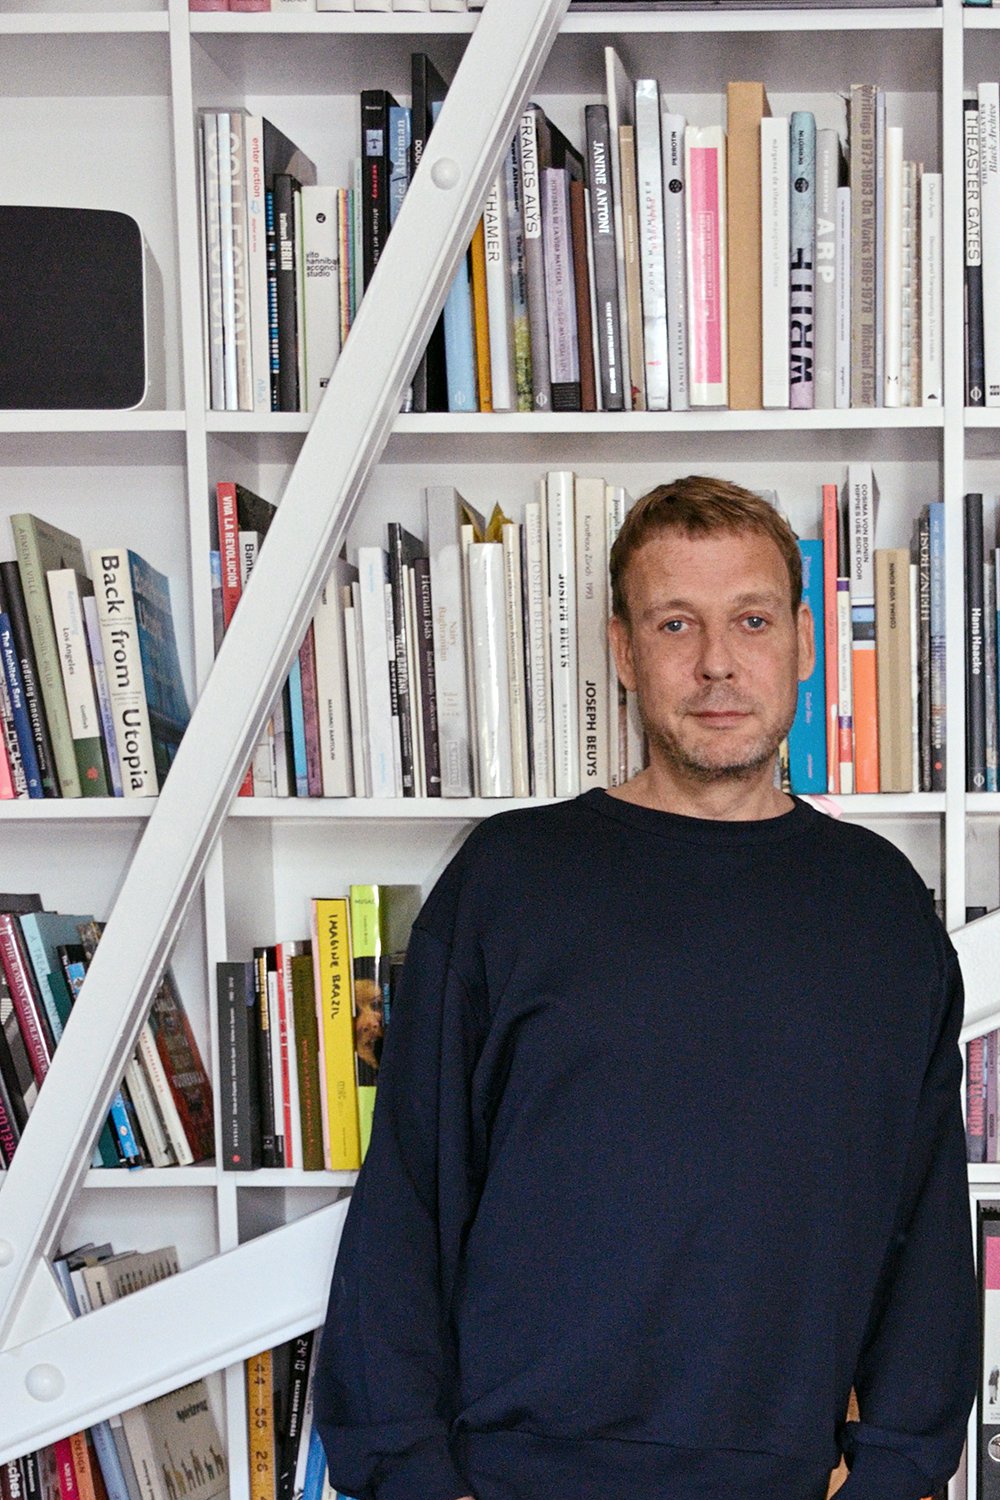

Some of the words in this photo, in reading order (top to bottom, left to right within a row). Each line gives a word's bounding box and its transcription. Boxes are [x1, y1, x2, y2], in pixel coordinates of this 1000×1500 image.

[252, 138, 262, 164] enter
[522, 116, 537, 188] FRANCIS
[593, 140, 606, 185] JANINE
[965, 117, 980, 201] THEASTER
[253, 167, 263, 198] action
[596, 188, 610, 235] ANTONI
[861, 200, 874, 216] On
[207, 132, 246, 347] COLLECTION
[816, 218, 835, 284] ARP
[861, 218, 874, 254] Works
[966, 207, 981, 261] GATES
[281, 241, 293, 270] BERLIN
[861, 256, 874, 314] 1969-1979
[862, 324, 875, 370] Michael
[862, 372, 875, 406] Asher
[223, 496, 234, 516] VIVA
[224, 518, 235, 531] LA
[225, 533, 241, 588] REVOLUCIÓN
[862, 538, 870, 564] BONIN
[100, 556, 125, 614] Back
[421, 575, 433, 618] Hernan
[532, 560, 547, 606] JOSEPH
[558, 574, 570, 621] JOSEPH
[2, 631, 12, 648] The
[63, 628, 71, 640] Los
[534, 610, 548, 650] BEUYS
[971, 608, 982, 635] Hans
[4, 649, 19, 687] Architect
[64, 642, 76, 676] Angeles
[110, 630, 133, 689] from
[559, 628, 571, 668] BEUYS
[972, 636, 983, 676] Haacke
[11, 688, 22, 708] Says
[21, 659, 36, 698] enduring
[29, 700, 43, 743] innocence
[535, 656, 549, 724] EDITIONEN
[585, 681, 597, 730] JOSEPH
[121, 709, 147, 791] Utopia
[586, 735, 598, 777] BEUYS
[328, 914, 341, 969] IMAGINE
[3, 940, 14, 958] THE
[9, 960, 25, 996] ROMAN
[18, 998, 39, 1043] CATHOLIC
[330, 974, 342, 1020] BRAZIL
[254, 1364, 266, 1386] 44
[256, 1407, 267, 1429] 55
[74, 1440, 86, 1473] DESIGN
